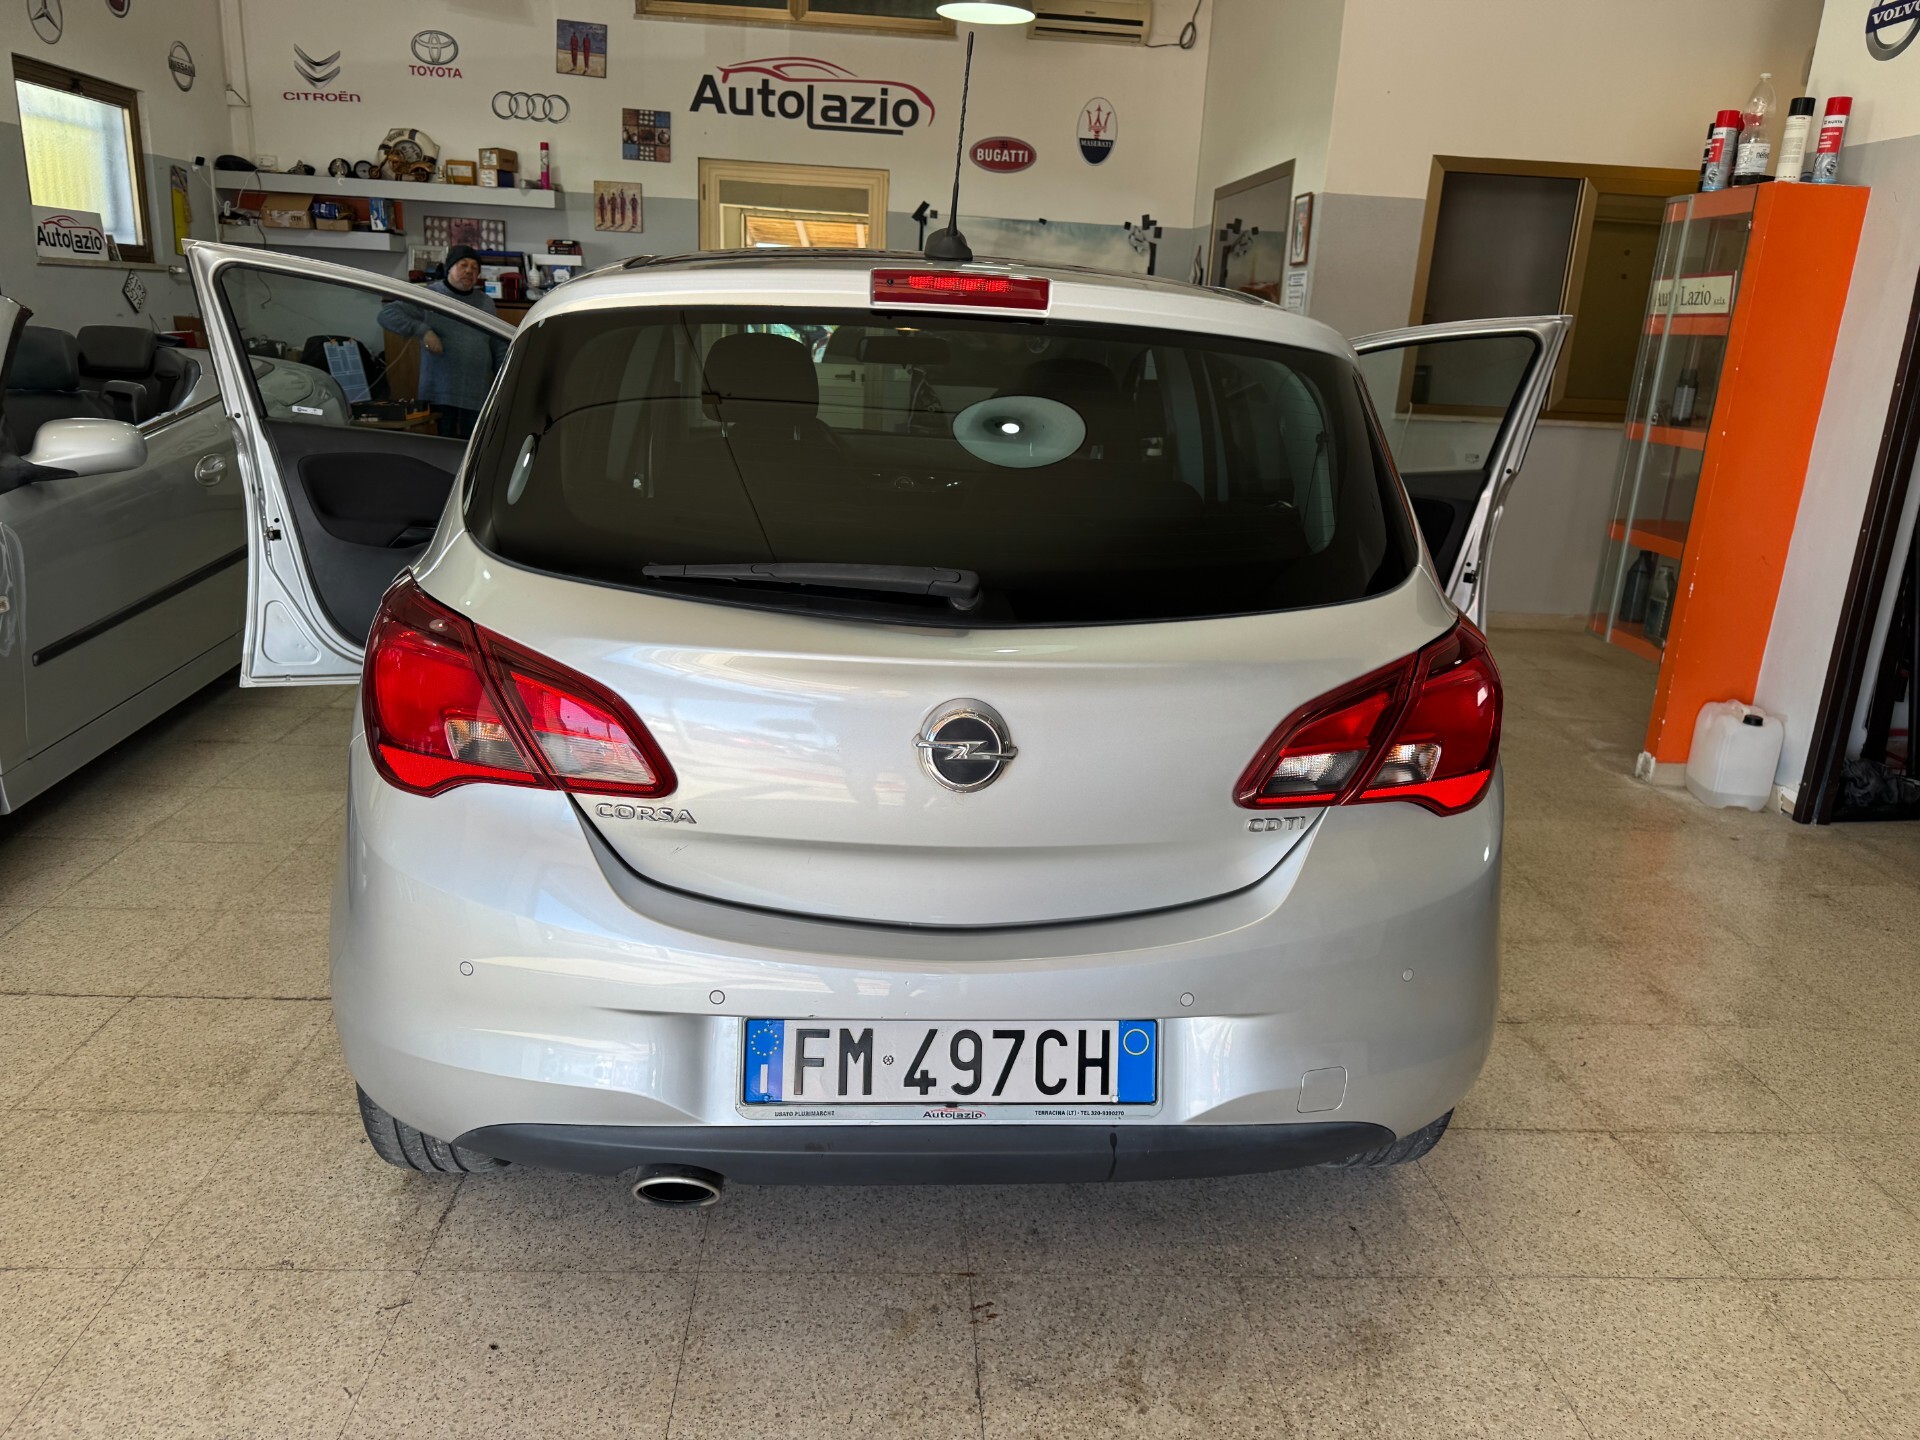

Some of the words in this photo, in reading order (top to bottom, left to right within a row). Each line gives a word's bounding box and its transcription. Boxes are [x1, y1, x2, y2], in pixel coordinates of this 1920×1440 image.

[409, 65, 463, 79] TOYOTA
[976, 148, 1029, 163] BUGATTI
[1680, 284, 1712, 306] Lazio
[595, 803, 697, 824] CORSA
[1247, 815, 1306, 833] CDTI
[793, 1027, 874, 1096] FM
[903, 1028, 1111, 1097] 497CH
